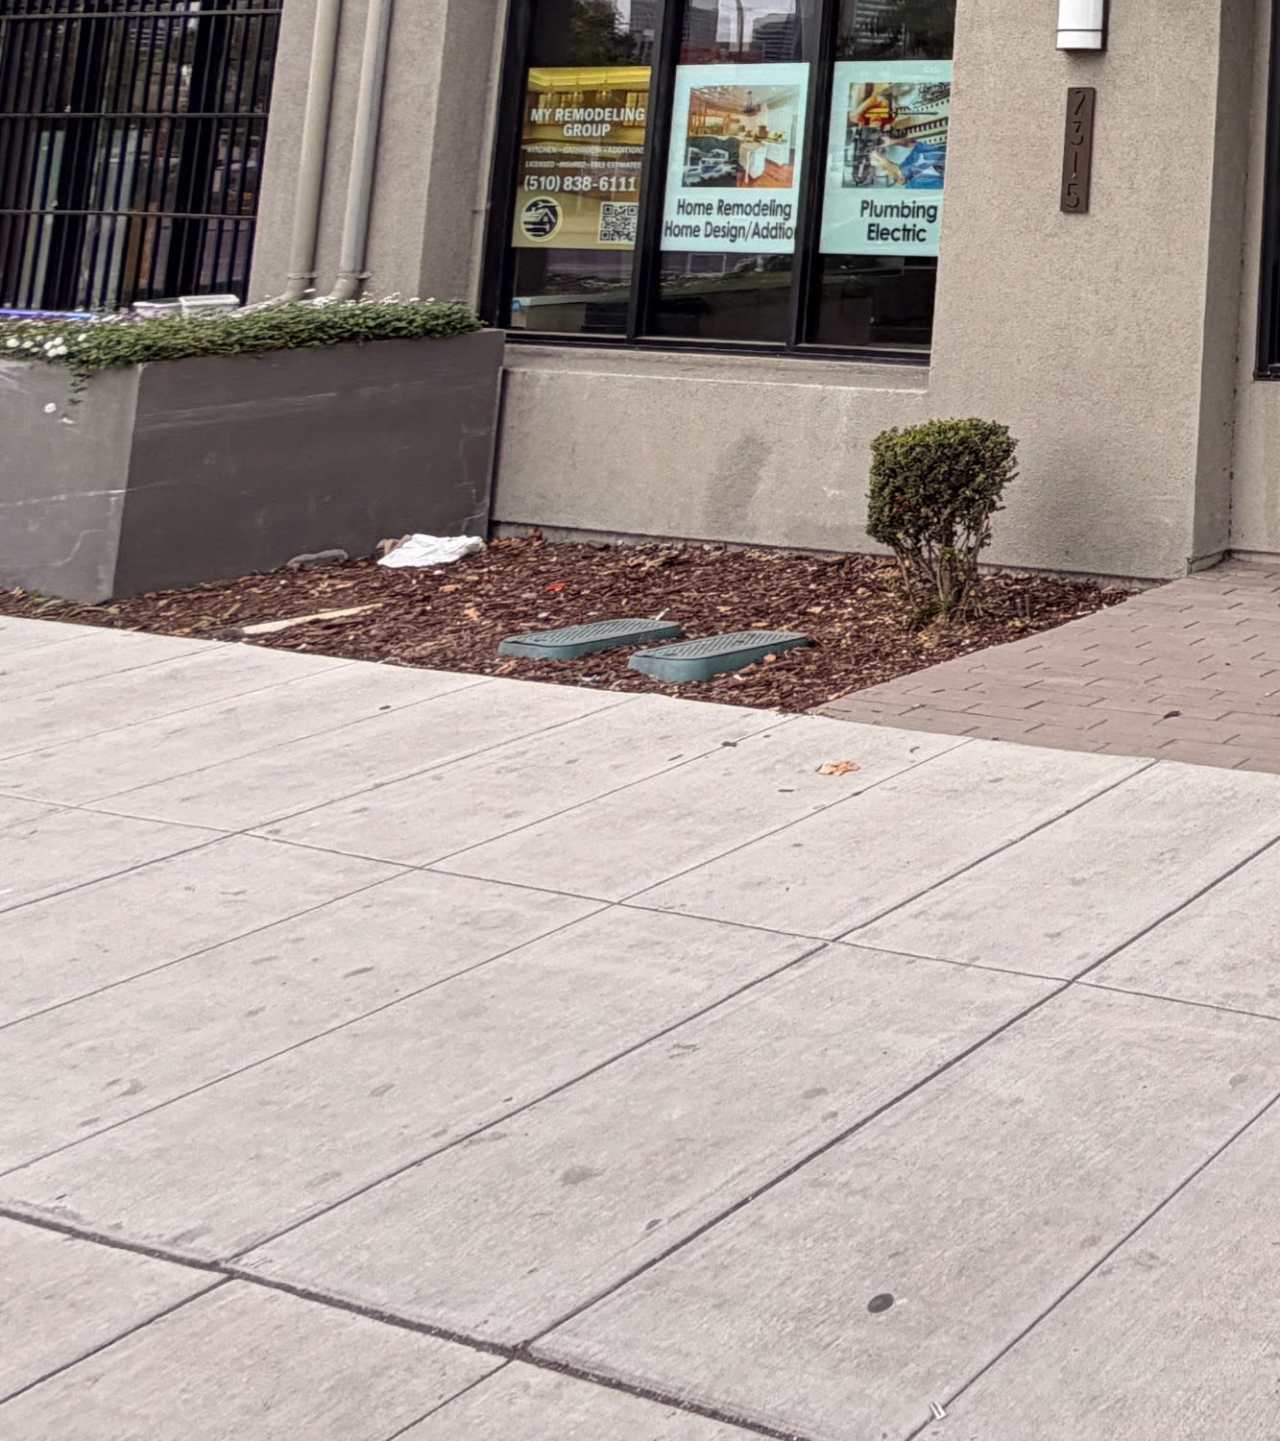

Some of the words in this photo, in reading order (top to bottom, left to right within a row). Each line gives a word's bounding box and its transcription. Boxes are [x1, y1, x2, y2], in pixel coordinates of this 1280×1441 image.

[531, 108, 552, 121] MY
[555, 107, 645, 121] REMODELING
[563, 123, 611, 137] GROUP
[524, 175, 560, 192] (510)
[563, 175, 637, 192] 838-6111
[676, 198, 713, 216] Home
[717, 198, 792, 221] Remodeling
[860, 199, 938, 223] Plumbing
[664, 220, 700, 237] Home
[867, 223, 927, 242] Electric
